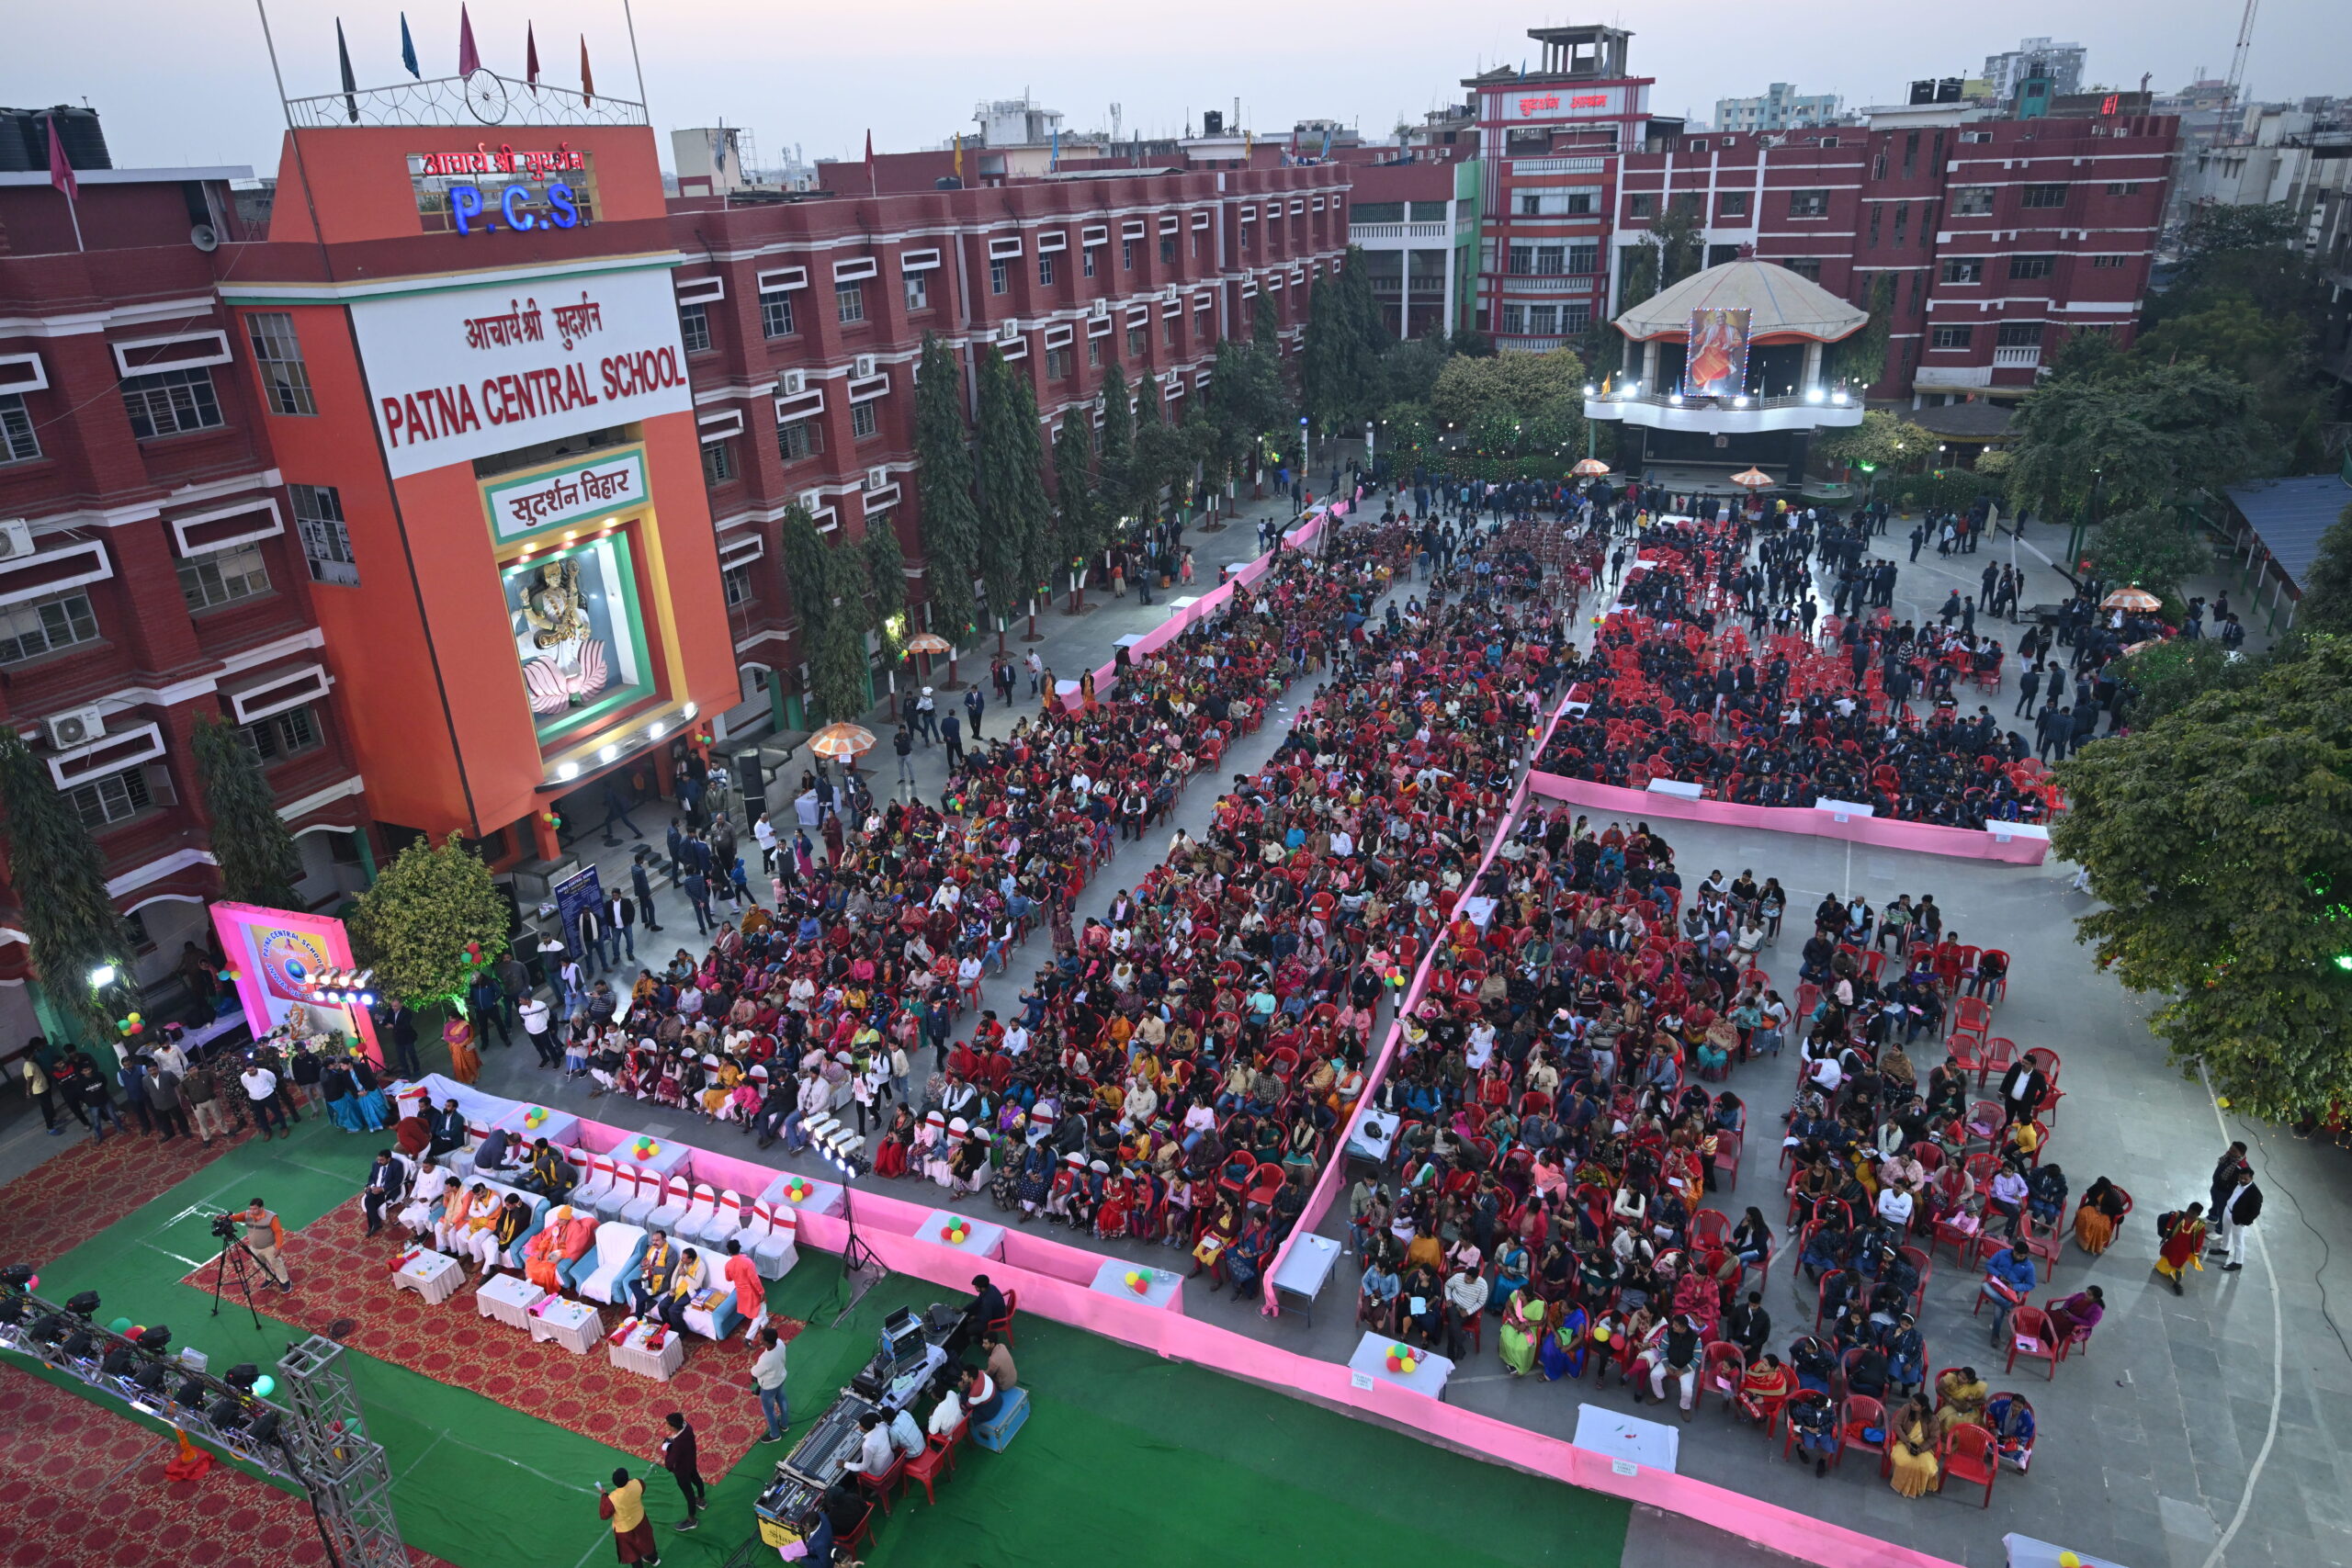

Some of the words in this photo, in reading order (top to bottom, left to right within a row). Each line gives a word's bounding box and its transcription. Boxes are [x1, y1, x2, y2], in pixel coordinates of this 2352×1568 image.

[1519, 93, 1560, 117] सुदर्शन
[423, 142, 489, 175] आचार्य
[493, 143, 517, 174] श्री
[522, 141, 585, 182] सुदर्शन
[551, 290, 603, 352] सुदर्शन
[381, 384, 481, 447] PATNA
[482, 362, 598, 425] CENTRAL
[601, 345, 687, 400] SCHOOL
[509, 479, 579, 526] सुदर्शन
[581, 470, 629, 502] विहार
[263, 937, 272, 957] PATNA
[269, 930, 300, 942] CENTRAL
[266, 963, 289, 992] ANNUAL
[289, 987, 302, 998] DAY
